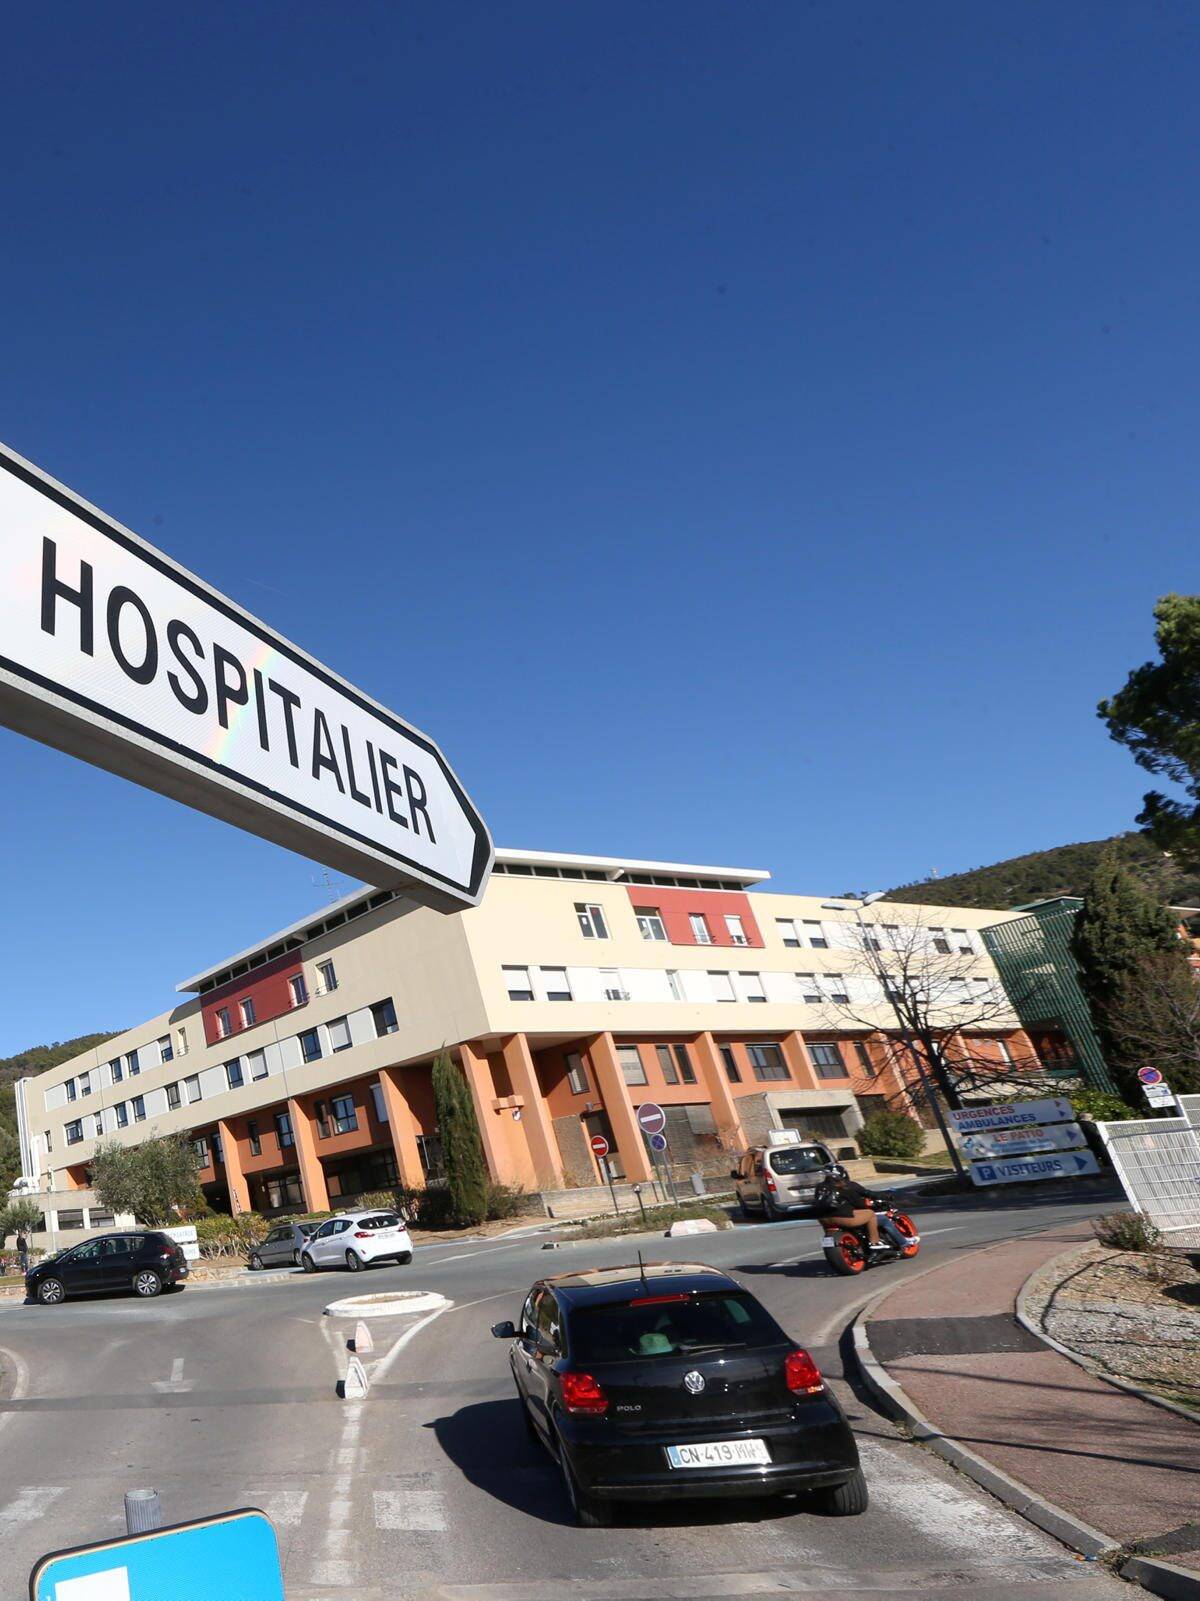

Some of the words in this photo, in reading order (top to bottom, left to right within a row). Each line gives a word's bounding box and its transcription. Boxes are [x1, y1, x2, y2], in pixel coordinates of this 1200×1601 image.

[40, 536, 437, 844] HOSPITALIER
[952, 1105, 1016, 1120] URGENCES
[958, 1113, 1037, 1131] AMBULANCES
[993, 1133, 1008, 1142] LE
[1011, 1129, 1044, 1141] PATIO
[996, 1160, 1063, 1177] VISITEURS
